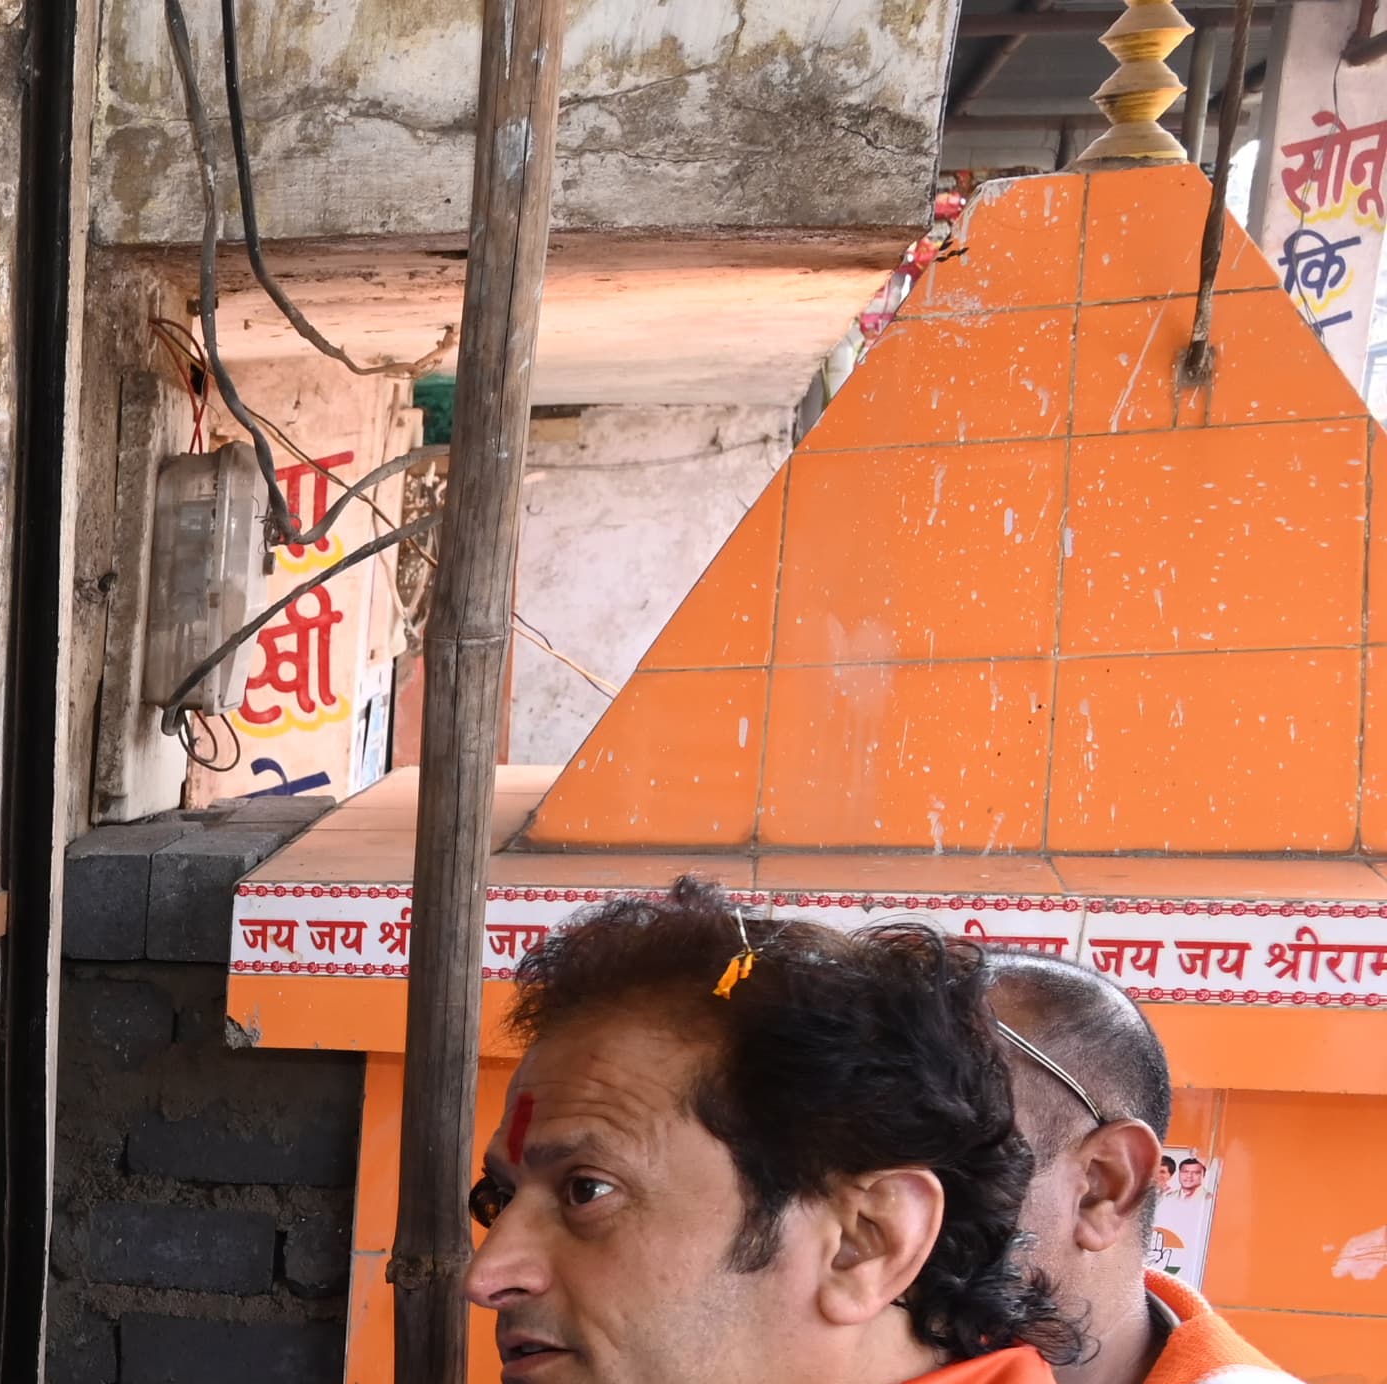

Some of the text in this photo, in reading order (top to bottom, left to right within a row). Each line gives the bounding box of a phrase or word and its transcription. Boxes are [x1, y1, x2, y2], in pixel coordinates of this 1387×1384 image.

[239, 918, 299, 954] जय
[306, 919, 369, 956] जय
[1088, 938, 1253, 981] जय जय
